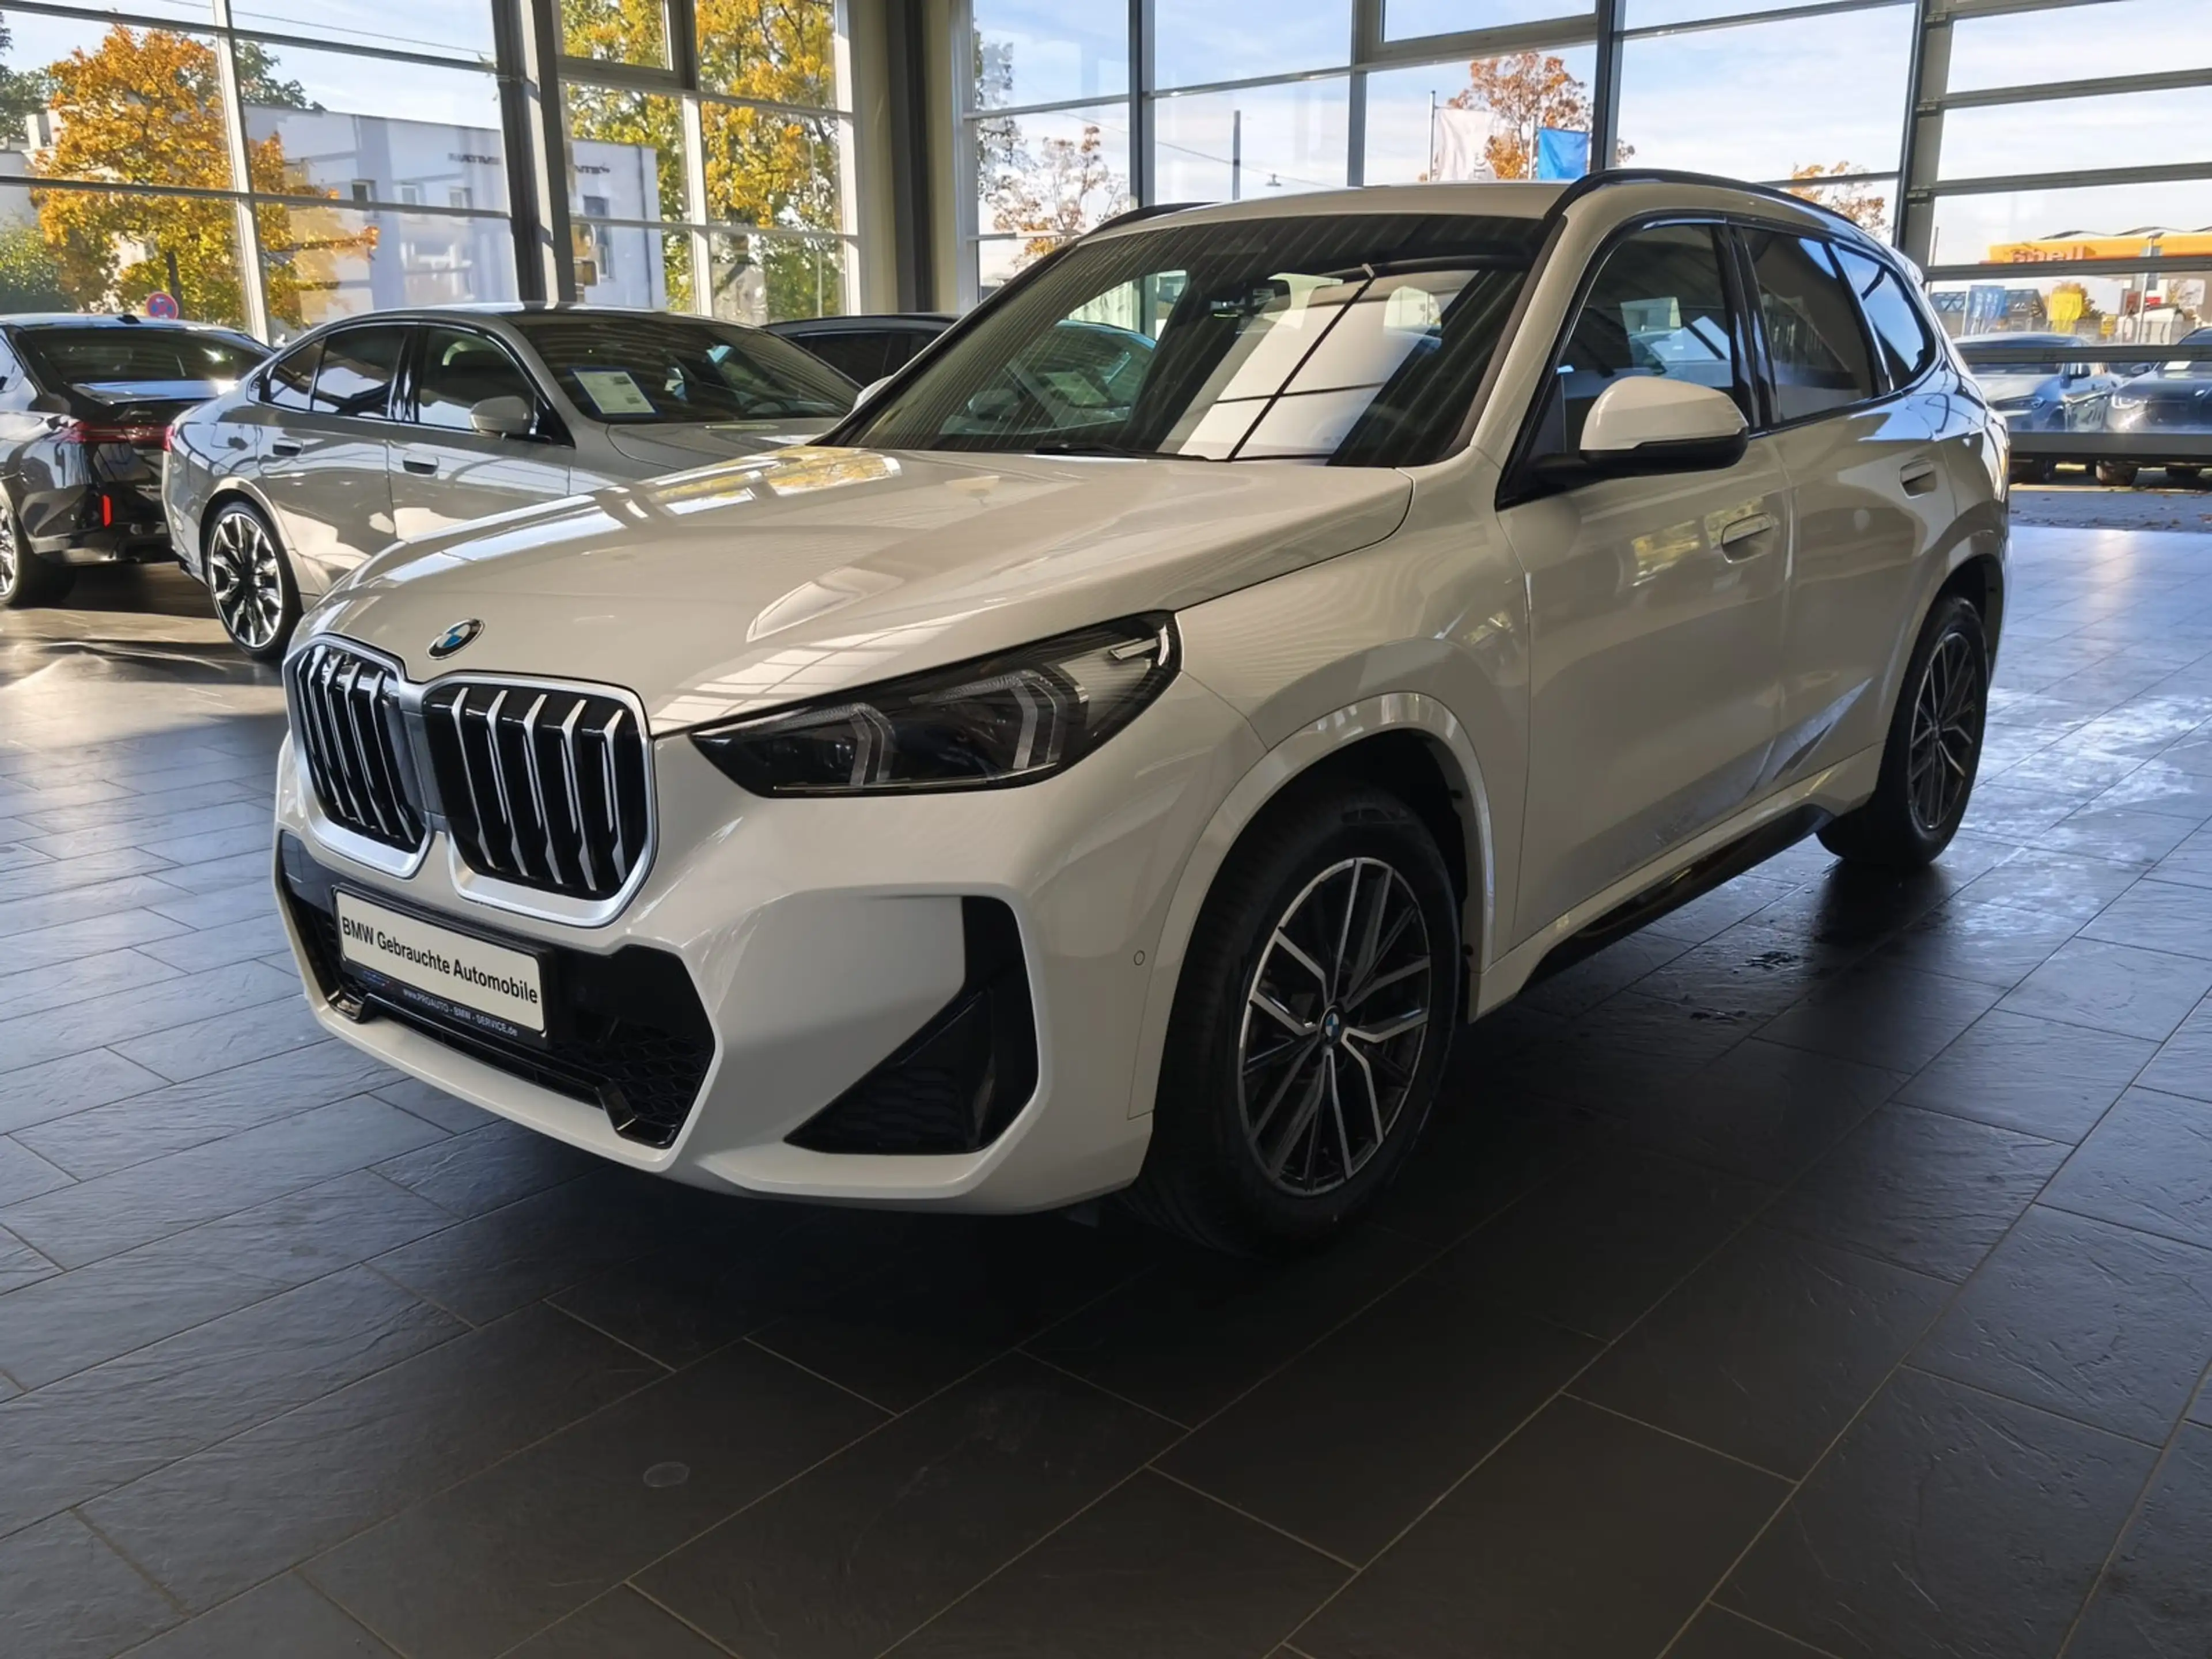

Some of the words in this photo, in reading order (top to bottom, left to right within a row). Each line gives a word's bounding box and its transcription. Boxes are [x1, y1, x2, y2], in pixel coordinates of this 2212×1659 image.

[342, 916, 373, 945] BMW
[377, 931, 450, 974] Gebrauchte
[453, 959, 537, 1003] Automobile
